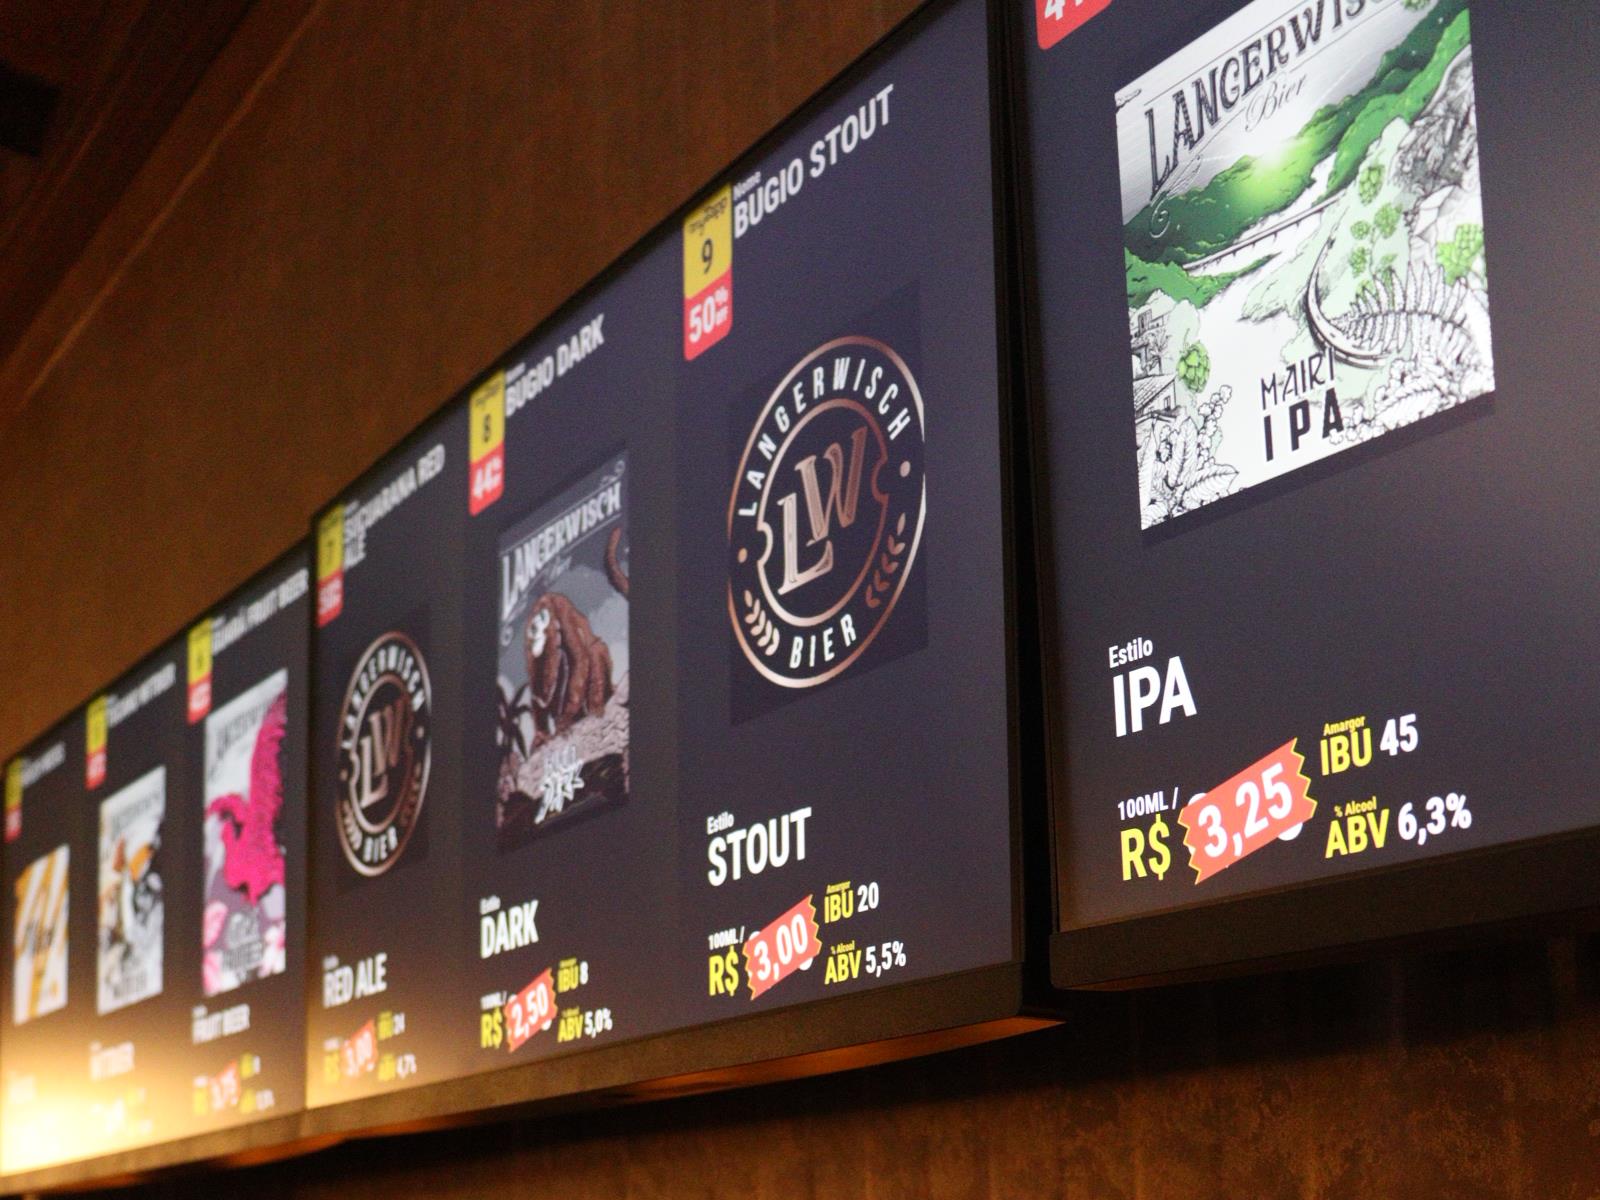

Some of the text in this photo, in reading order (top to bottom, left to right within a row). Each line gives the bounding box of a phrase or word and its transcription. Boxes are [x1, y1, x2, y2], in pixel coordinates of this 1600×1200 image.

[1245, 72, 1307, 132] Bier
[734, 84, 893, 240] BUGIO STOUT
[702, 237, 713, 275] 9
[557, 313, 604, 377] DARK
[1261, 347, 1334, 410] MAIRI
[738, 357, 911, 516] LANGERWISCH
[1264, 387, 1344, 462] IPA
[778, 426, 868, 594] LW
[789, 613, 857, 669] BIER
[1108, 637, 1153, 669] Estilo
[1113, 656, 1197, 737] IPA
[1320, 713, 1418, 776] IBU 45
[1323, 716, 1366, 738] Amargor
[707, 811, 734, 835] Estilo
[1118, 791, 1168, 820] 100ML
[1120, 762, 1292, 881] R$ 3,25
[1325, 792, 1472, 859] ABV 6,3%
[1345, 795, 1377, 816] Alcool
[708, 806, 812, 887] STOUT
[480, 900, 539, 959] DARK
[824, 890, 854, 923] IBU
[857, 882, 879, 912] 20
[355, 952, 387, 999] ALE
[557, 965, 579, 993] IBU
[580, 961, 589, 985] 8
[708, 914, 808, 997] R$ 3,00
[824, 941, 906, 985] ABV 5,5%
[480, 982, 549, 1049] R$ 2,50
[557, 1007, 613, 1043] ABV 5,0%
